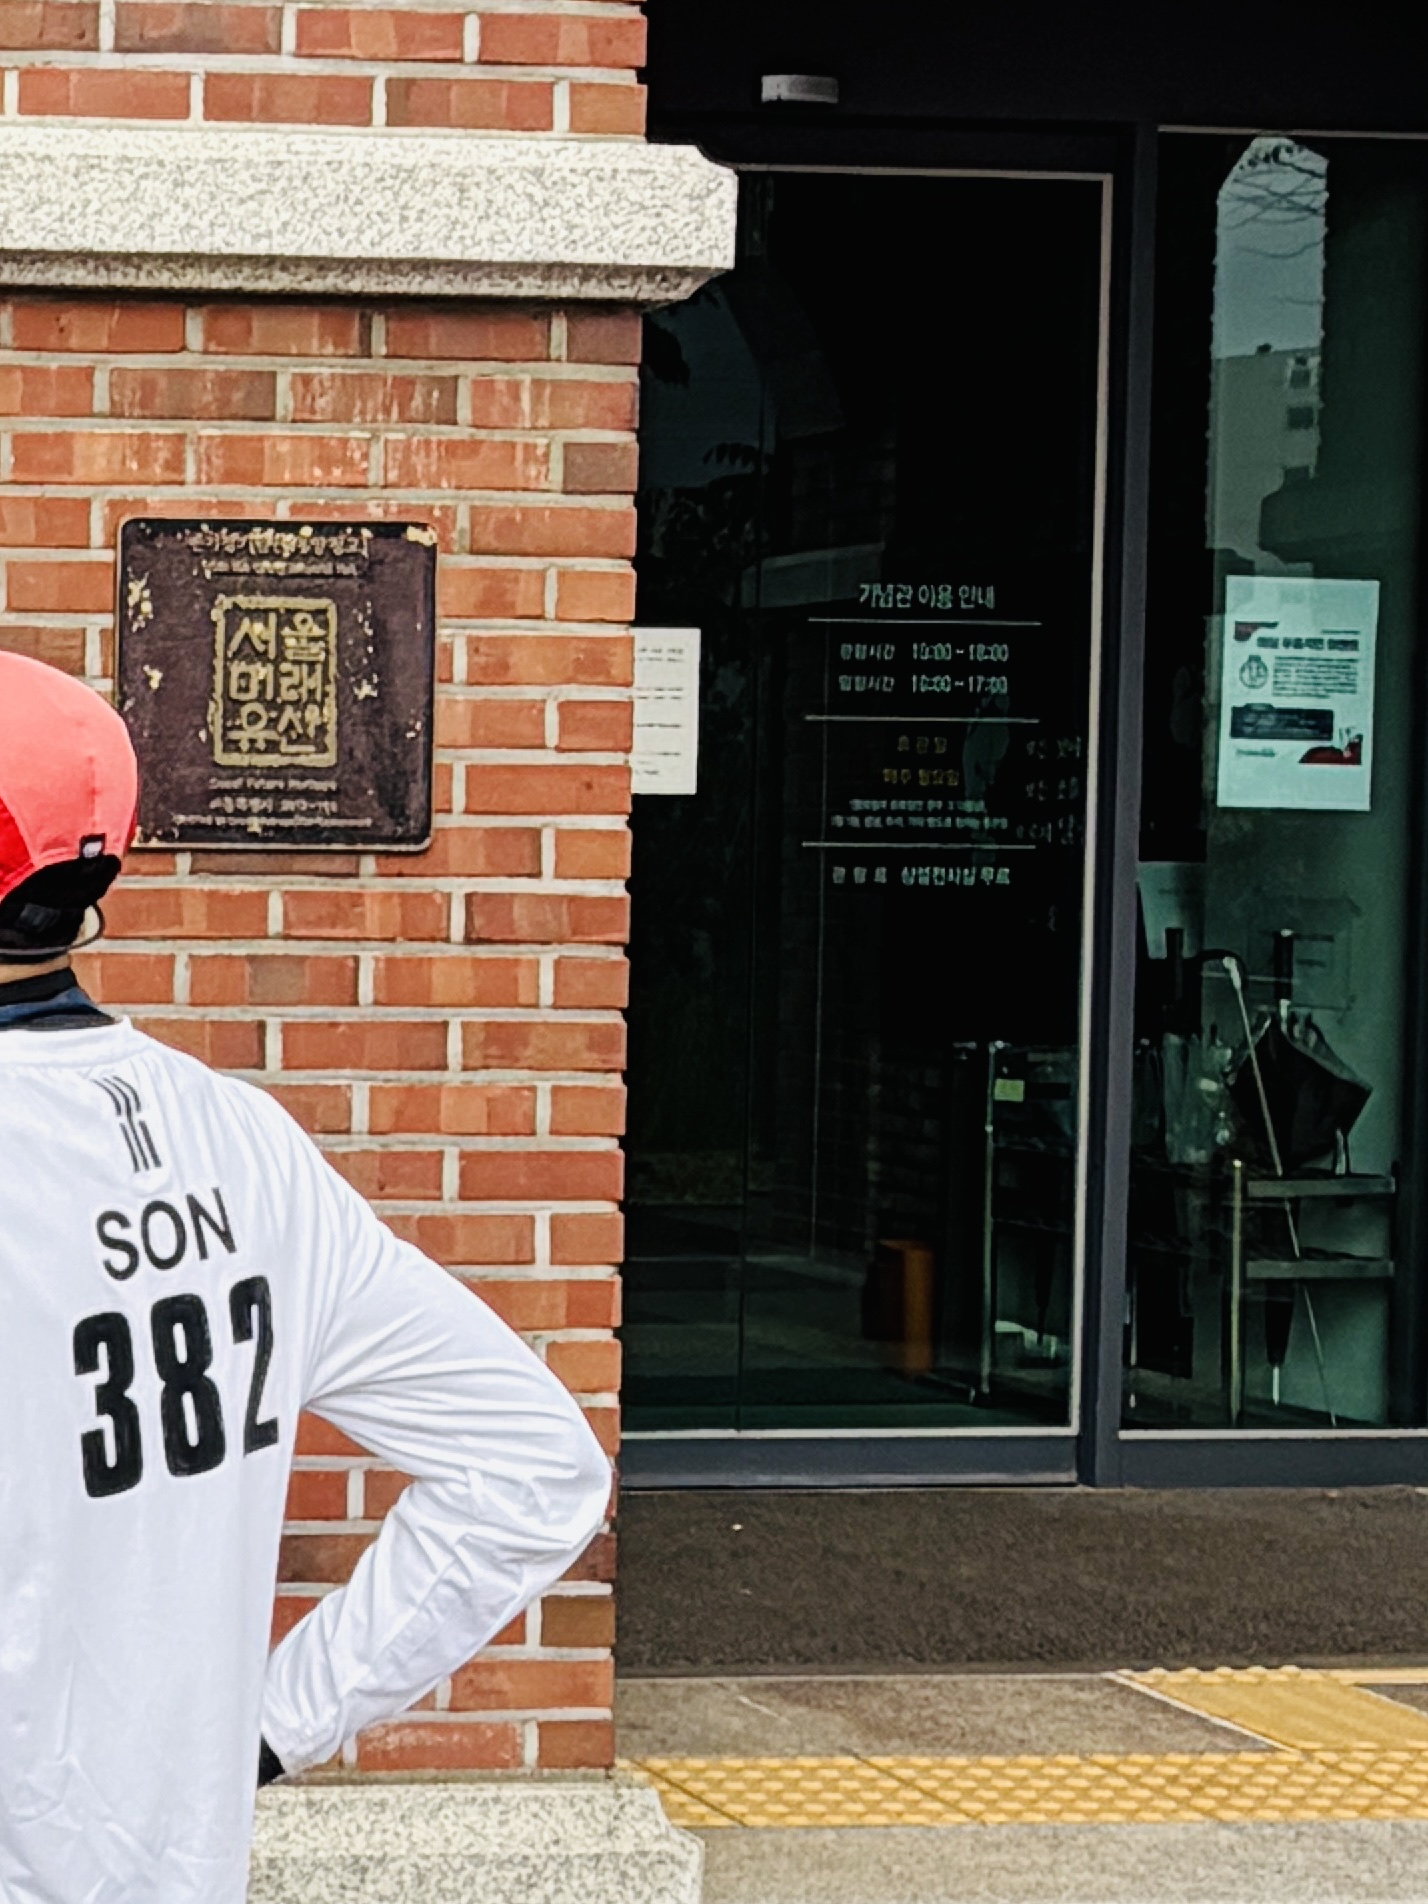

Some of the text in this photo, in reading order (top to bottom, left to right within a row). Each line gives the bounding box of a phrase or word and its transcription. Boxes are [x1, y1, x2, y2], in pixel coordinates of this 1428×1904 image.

[859, 583, 995, 610] 기념관 이용 안내
[227, 612, 326, 662] 서울
[228, 661, 324, 703] 미래
[225, 703, 326, 754] 유산
[96, 1187, 238, 1282] SON
[73, 1275, 280, 1499] 382
